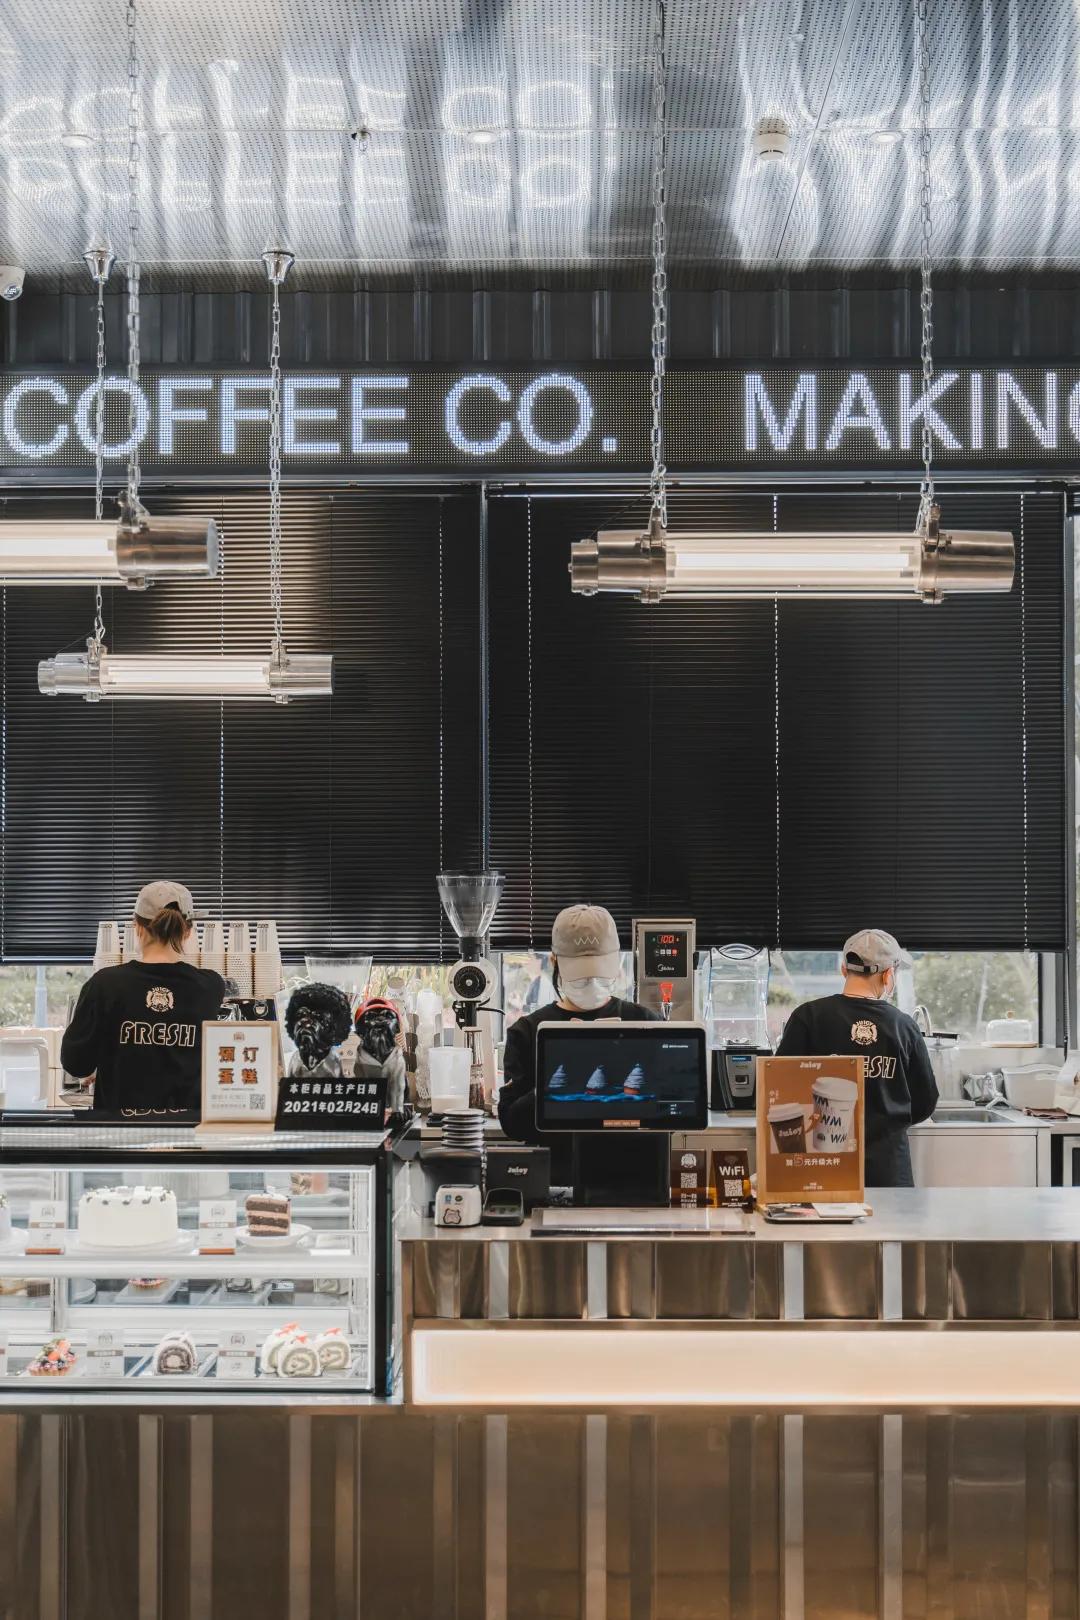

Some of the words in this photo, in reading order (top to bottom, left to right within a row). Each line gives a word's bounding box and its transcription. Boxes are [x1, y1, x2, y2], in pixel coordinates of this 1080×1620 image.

[3, 374, 410, 458] COFFEE
[443, 373, 618, 456] CO.
[743, 373, 1080, 453] MAKIN
[660, 935, 674, 944] 100
[120, 1021, 196, 1047] FRESH
[289, 1083, 378, 1095] 本柜商品生产日期
[284, 1100, 379, 1115] 2021年02月24日
[719, 1165, 744, 1176] WiFi
